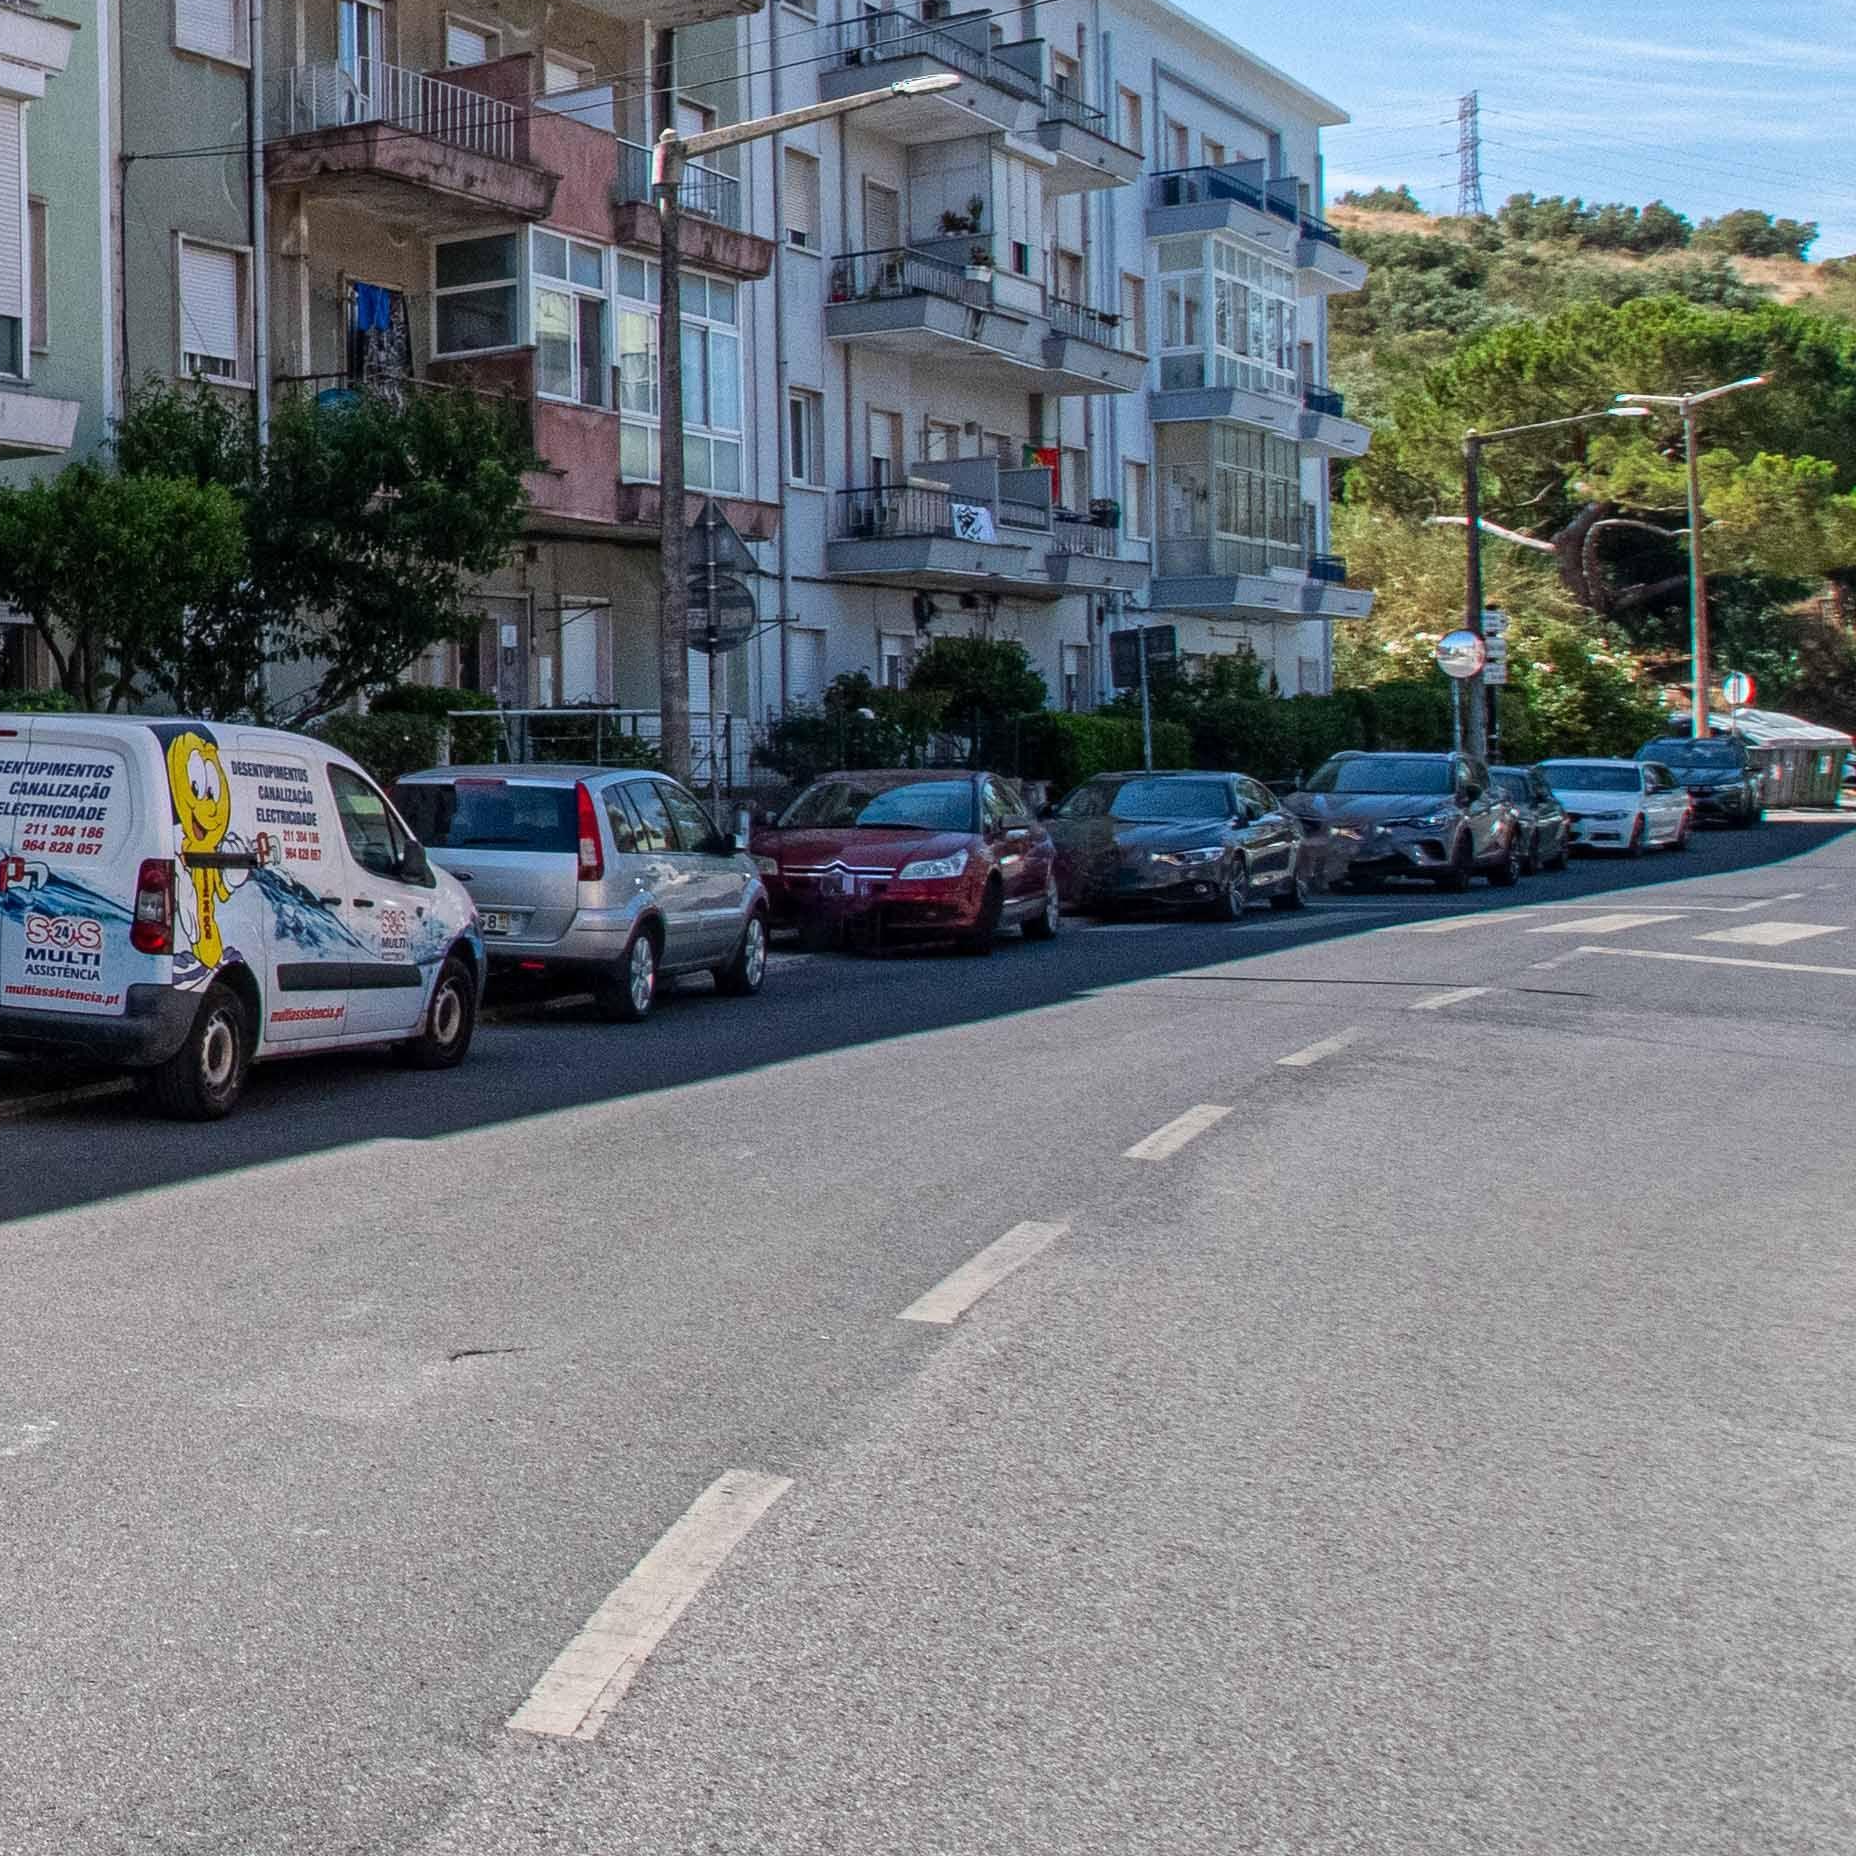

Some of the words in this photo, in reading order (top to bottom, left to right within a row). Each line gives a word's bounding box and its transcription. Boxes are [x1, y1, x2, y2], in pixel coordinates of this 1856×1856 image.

[231, 760, 309, 783] DESENTUPIMENTOS
[9, 782, 111, 803] CANALIZAÇÃO
[23, 822, 48, 836] 211
[51, 824, 76, 838] 304
[80, 826, 105, 840] 186
[21, 838, 45, 852] 964
[48, 840, 74, 854] 828
[76, 843, 104, 856] 057
[25, 916, 103, 950] SOS
[25, 947, 101, 967] MULTI
[25, 963, 101, 982] ASSISTÊNCIA
[4, 984, 120, 1006] multiassistencia.pt
